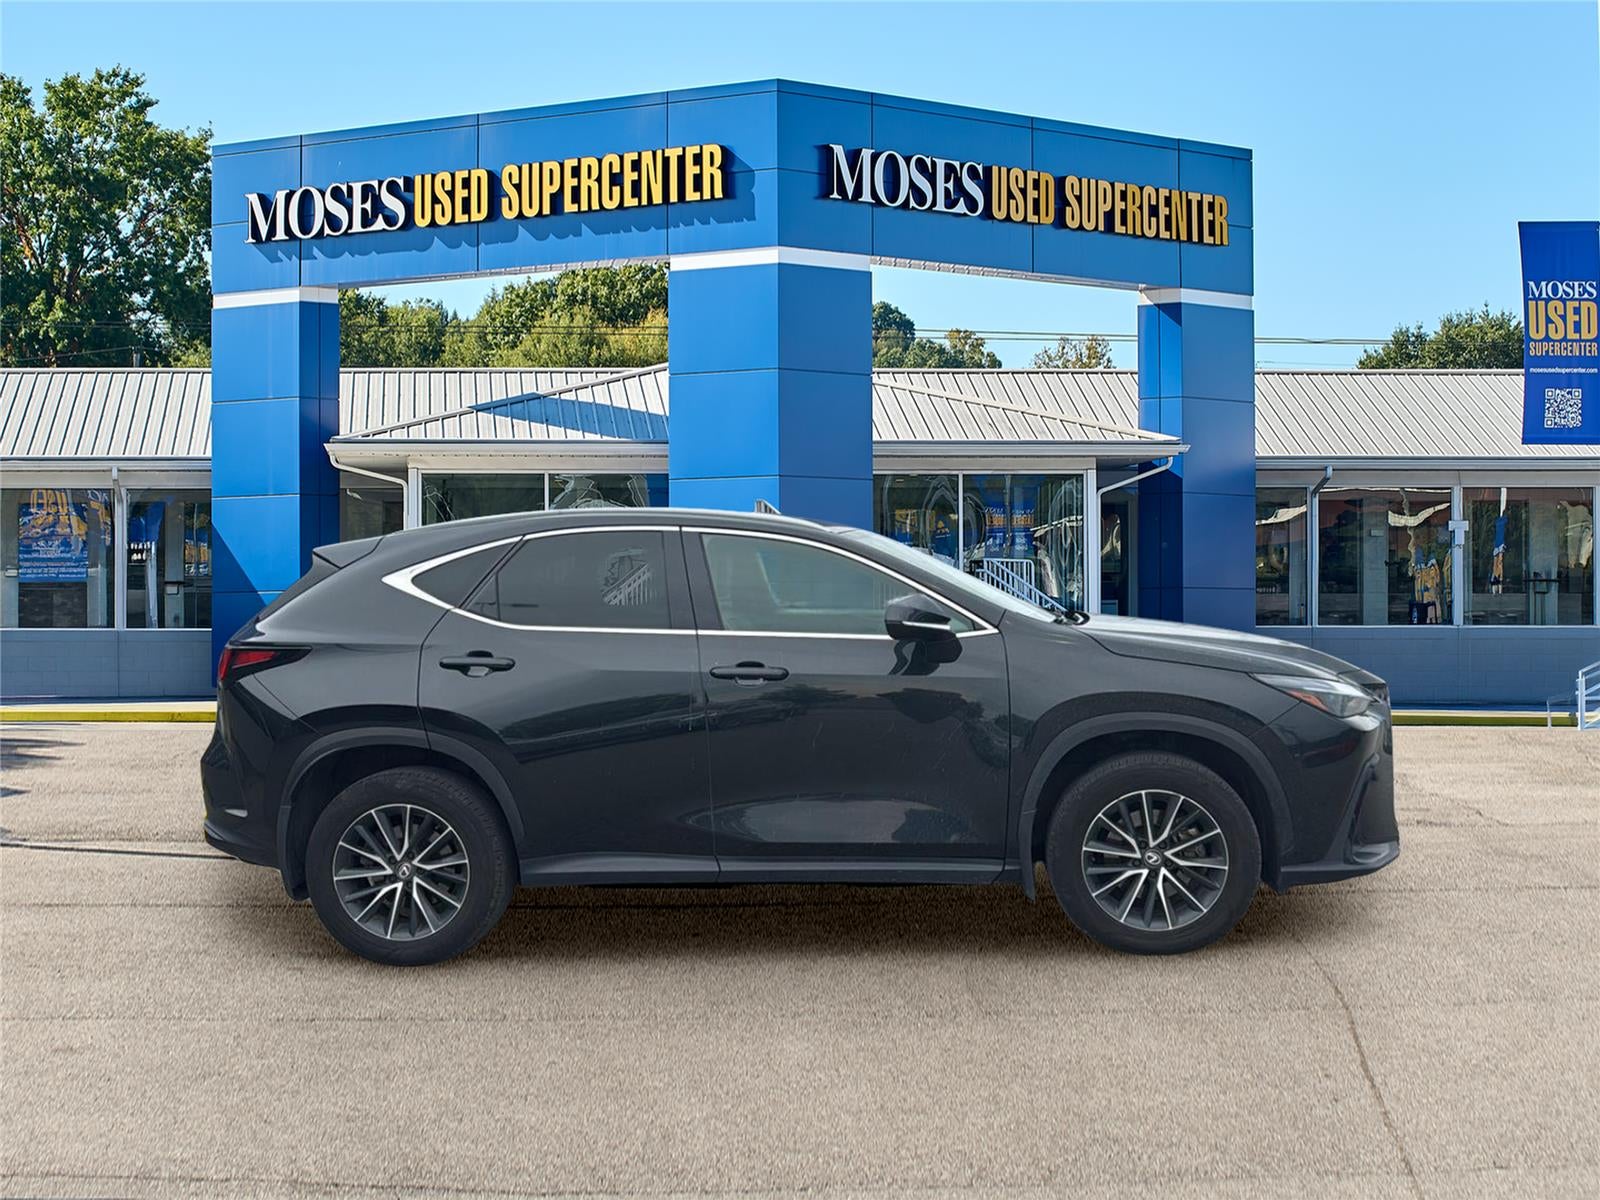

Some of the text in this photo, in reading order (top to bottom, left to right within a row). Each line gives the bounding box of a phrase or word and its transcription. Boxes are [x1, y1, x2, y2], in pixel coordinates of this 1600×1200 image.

[244, 143, 724, 244] MOSES USED SUPERCENTER
[829, 144, 1229, 246] MOSES USED SUPERCENTER
[1528, 281, 1597, 299] MOSES
[1528, 301, 1598, 340] USED
[1529, 342, 1598, 357] SUPERCENTER
